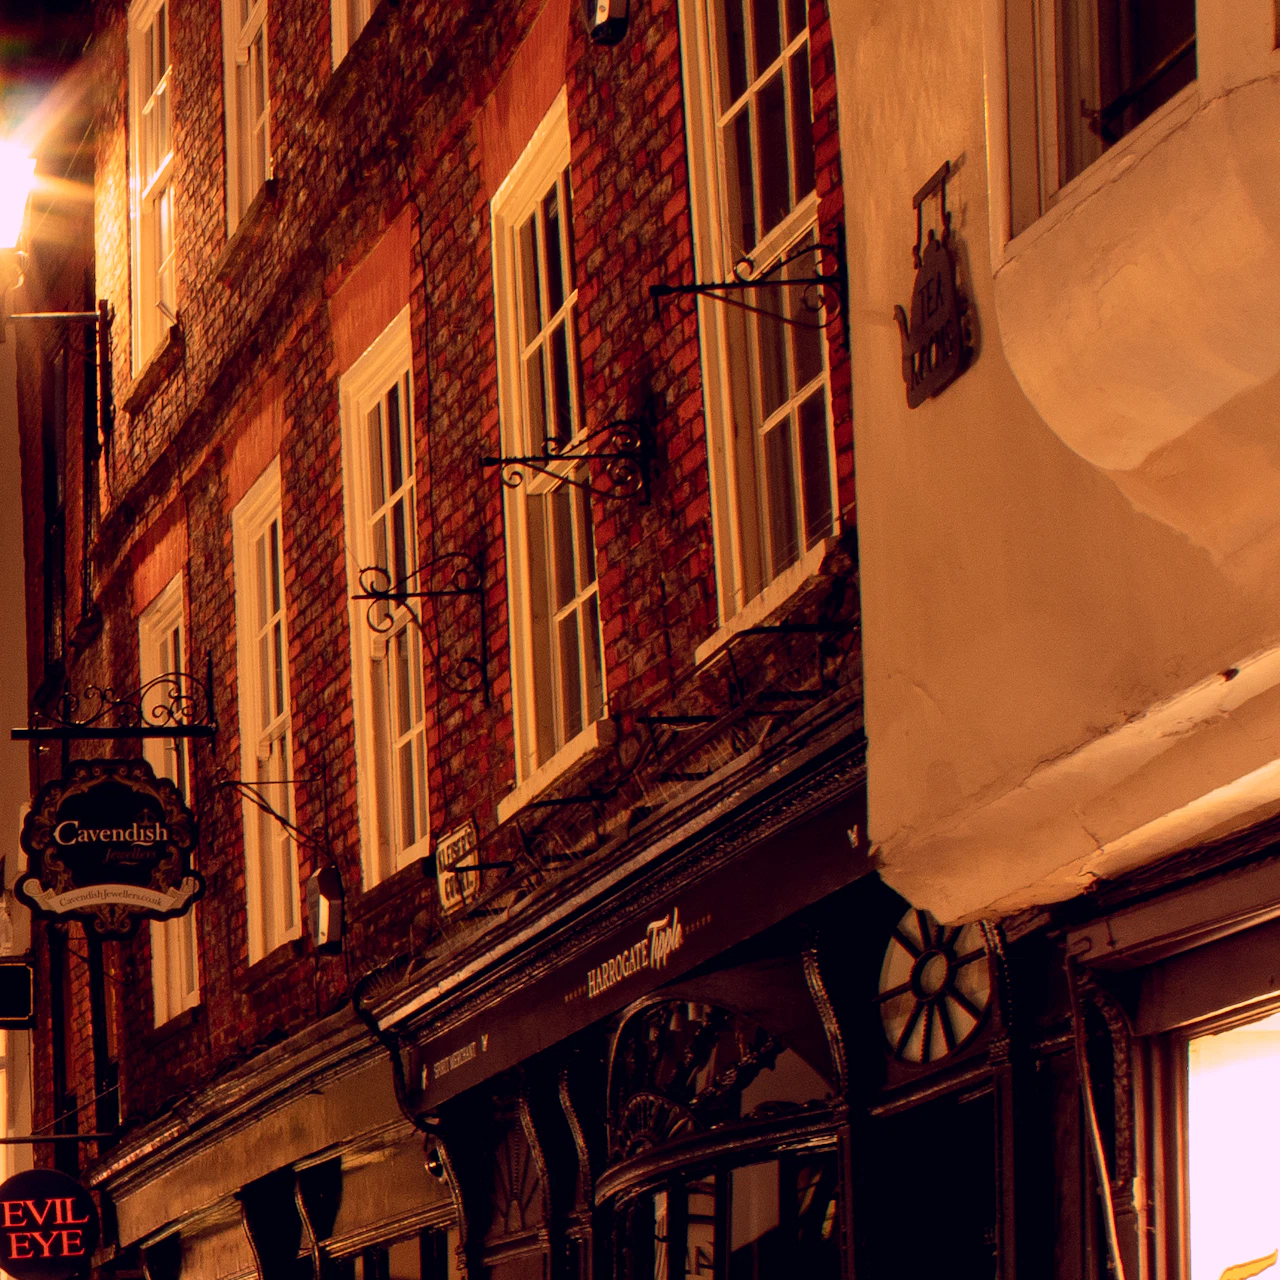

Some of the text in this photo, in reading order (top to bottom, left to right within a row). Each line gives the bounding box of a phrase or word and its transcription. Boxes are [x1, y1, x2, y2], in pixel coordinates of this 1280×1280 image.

[918, 270, 944, 326] TEA
[52, 819, 169, 847] Cavendish
[102, 847, 158, 865] Jewellers
[587, 905, 684, 999] HARROGATE Tipple
[0, 1197, 90, 1228] EVIL
[6, 1229, 86, 1260] EYE
